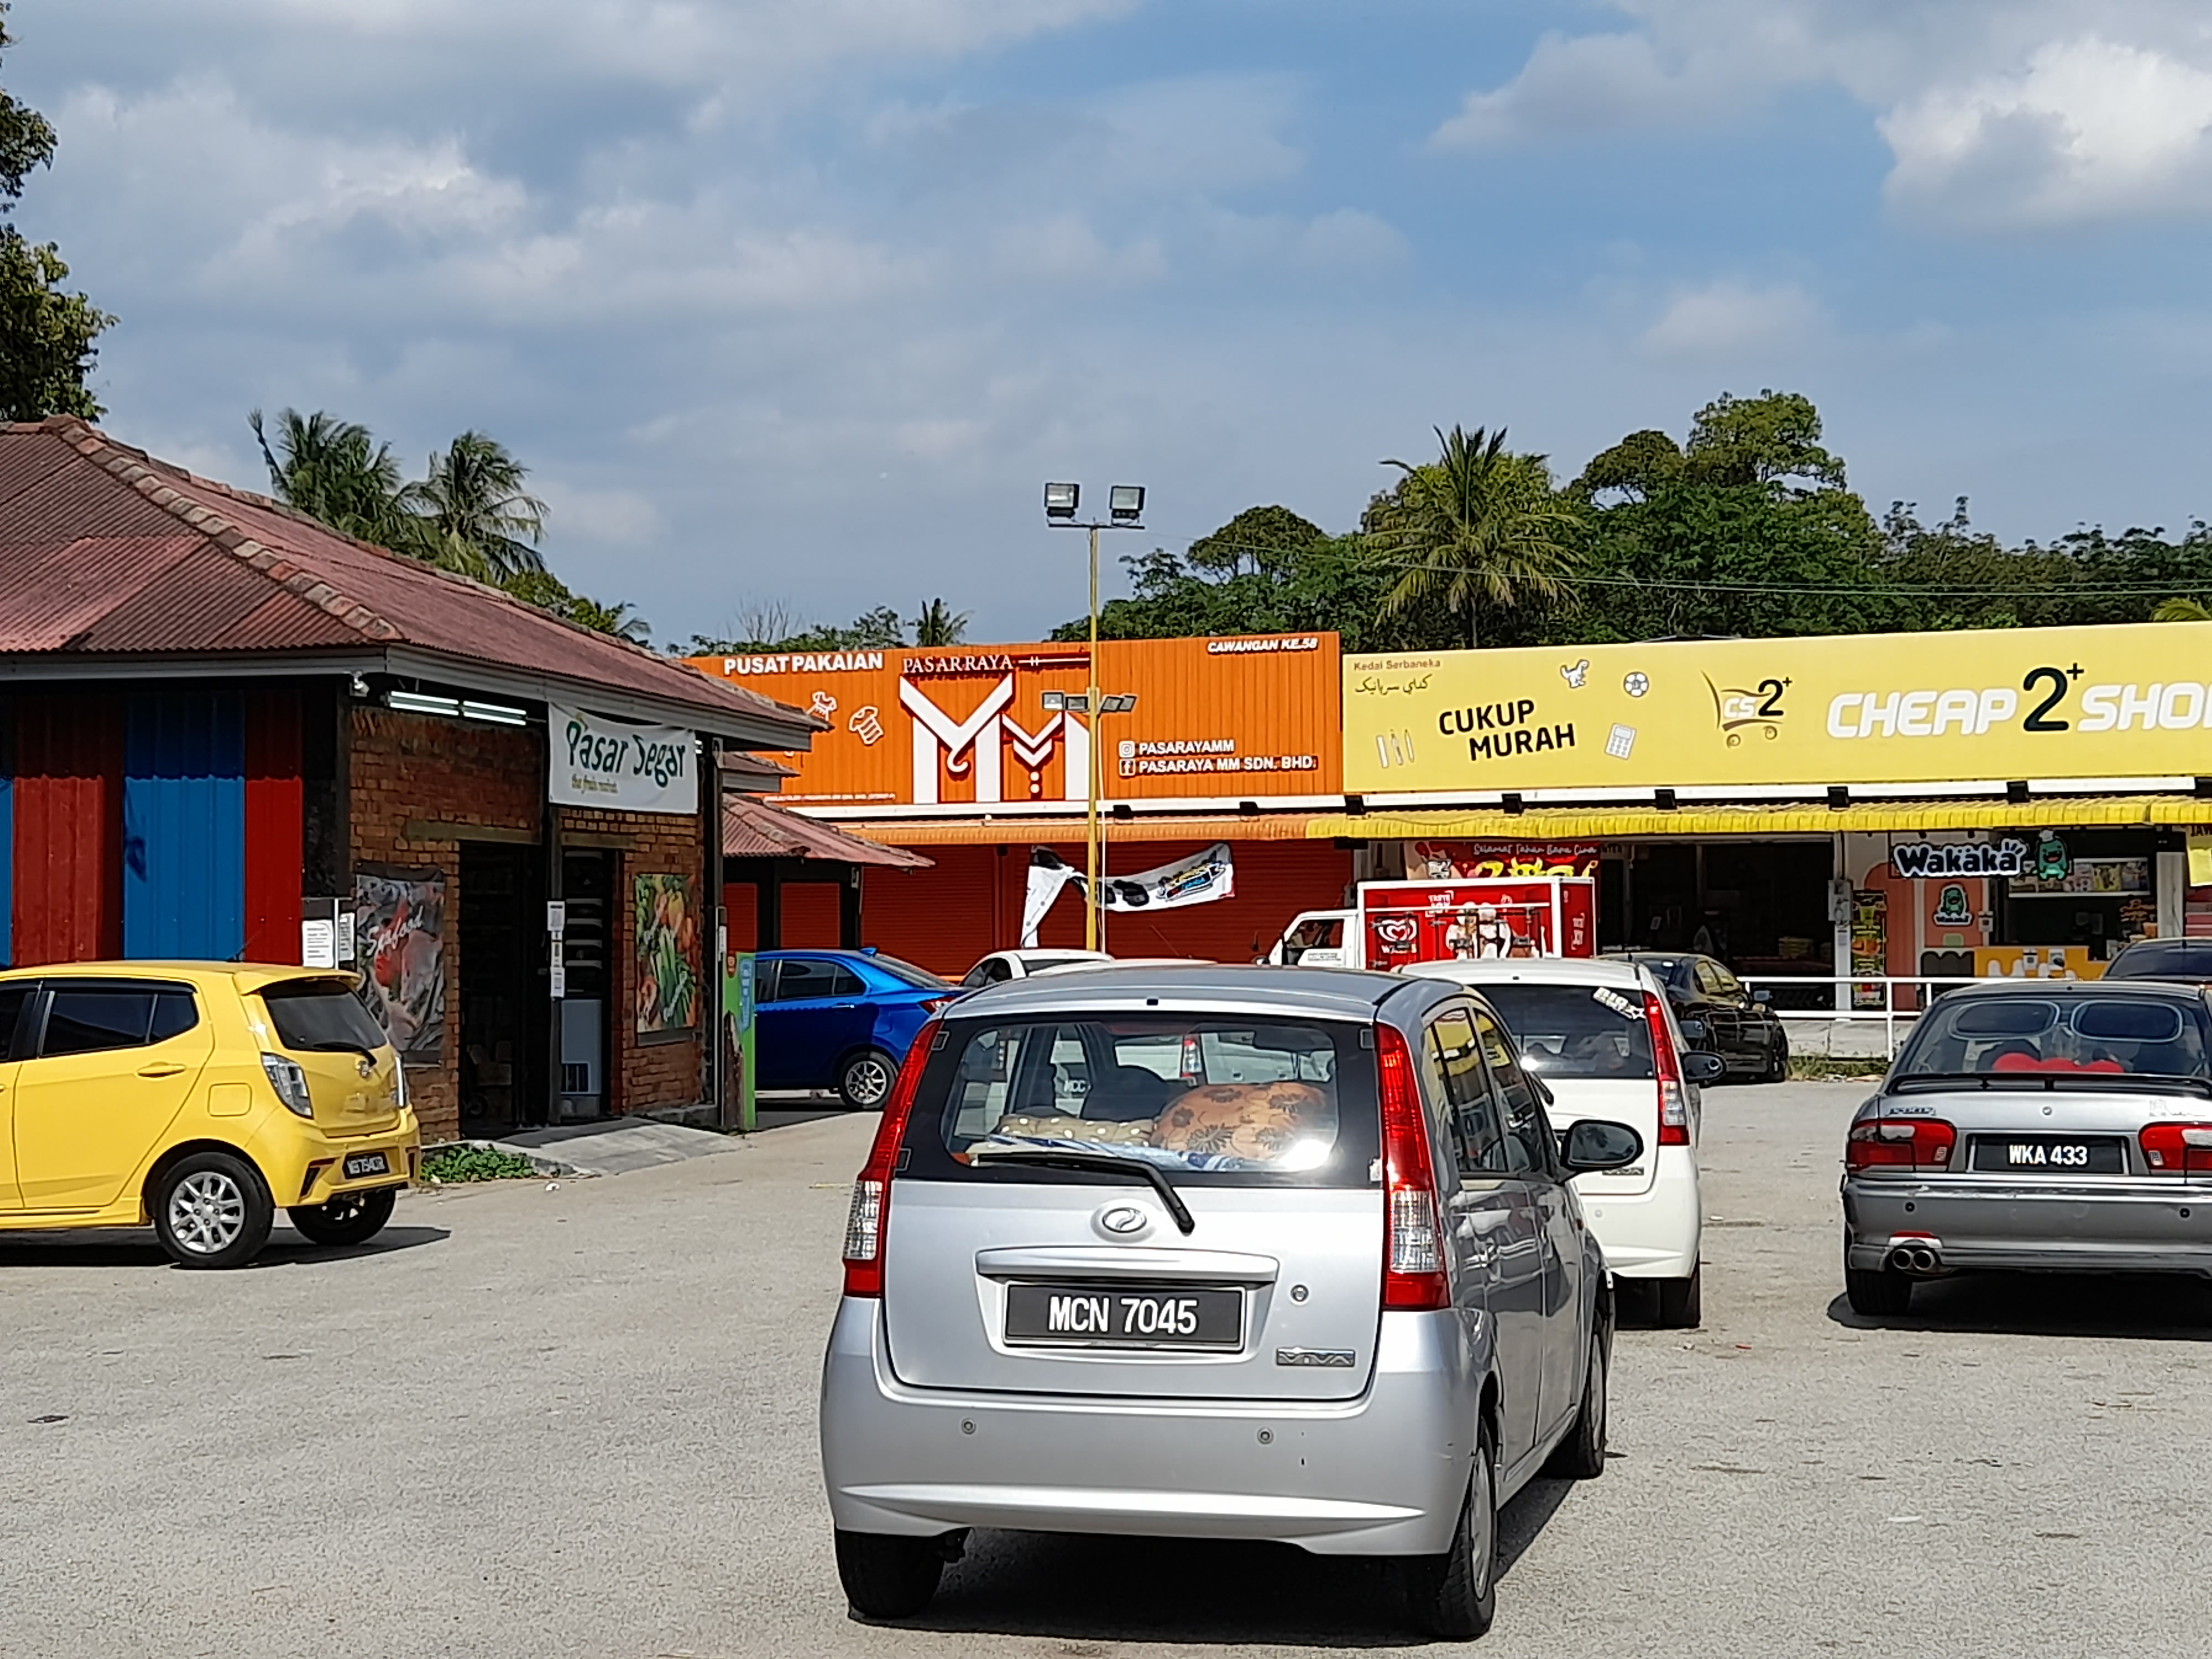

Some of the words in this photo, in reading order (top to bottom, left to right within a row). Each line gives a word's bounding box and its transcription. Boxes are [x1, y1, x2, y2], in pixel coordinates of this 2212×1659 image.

[1208, 639, 1278, 652] CAWANGAN
[724, 656, 790, 675] PUSAT
[792, 653, 883, 671] PAKAIAN
[1354, 661, 1383, 671] Kedai
[1386, 659, 1441, 669] Serbaneka
[1439, 699, 1535, 735] CUKUP
[1827, 688, 2018, 739] CHEAP
[2077, 682, 2212, 732] SHO
[1139, 740, 1234, 755] PASARAYAMM
[1469, 723, 1575, 761] MURAH
[566, 721, 629, 774] Pasar
[633, 734, 685, 788] Segar
[1139, 759, 1214, 773] PASARAYA
[1217, 758, 1240, 770] MM
[1244, 757, 1277, 770] SDN.
[2008, 1145, 2047, 1165] WKA
[2050, 1145, 2088, 1165] 433
[1049, 1297, 1109, 1332] MCN
[1120, 1298, 1198, 1334] 7045
[1277, 1350, 1354, 1366] VIVA
